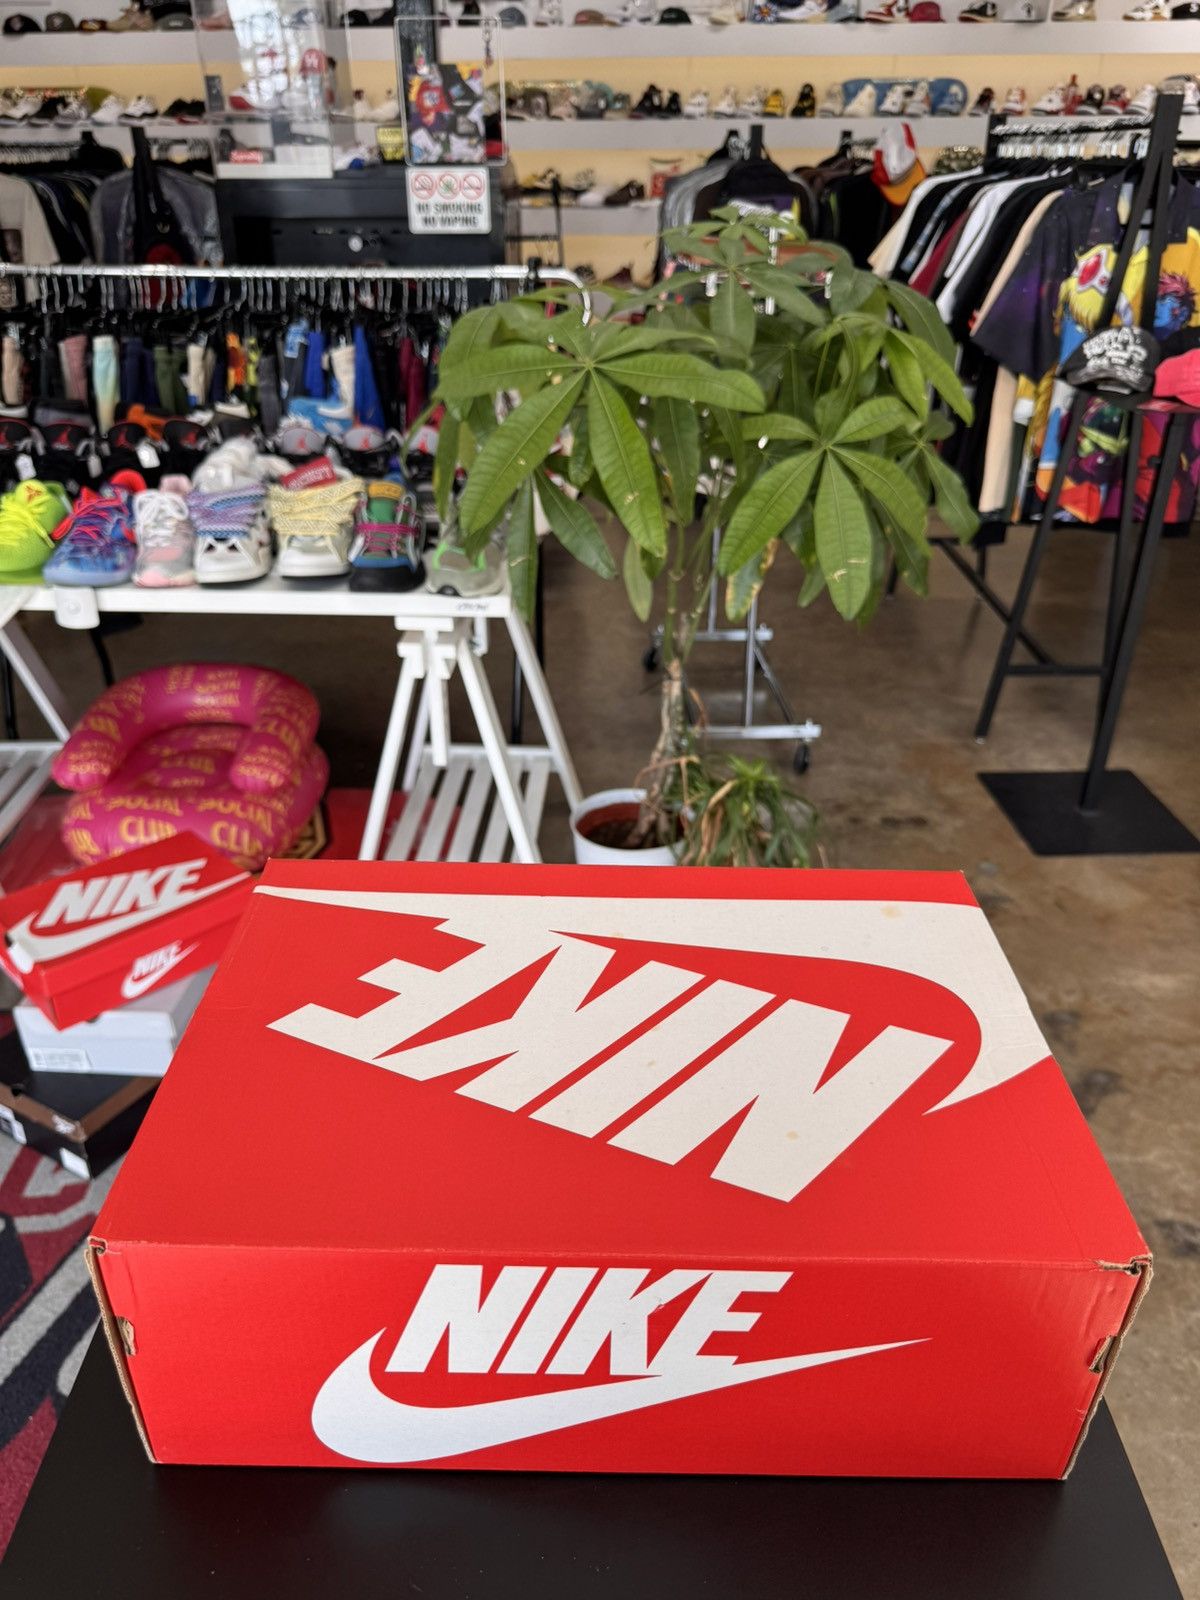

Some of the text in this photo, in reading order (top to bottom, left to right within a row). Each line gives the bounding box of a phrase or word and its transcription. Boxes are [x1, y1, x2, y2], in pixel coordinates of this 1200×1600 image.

[34, 857, 208, 929] NIKE
[132, 940, 184, 980] NIKE
[266, 915, 955, 1203] NIKE
[384, 1263, 794, 1377] NIKE
